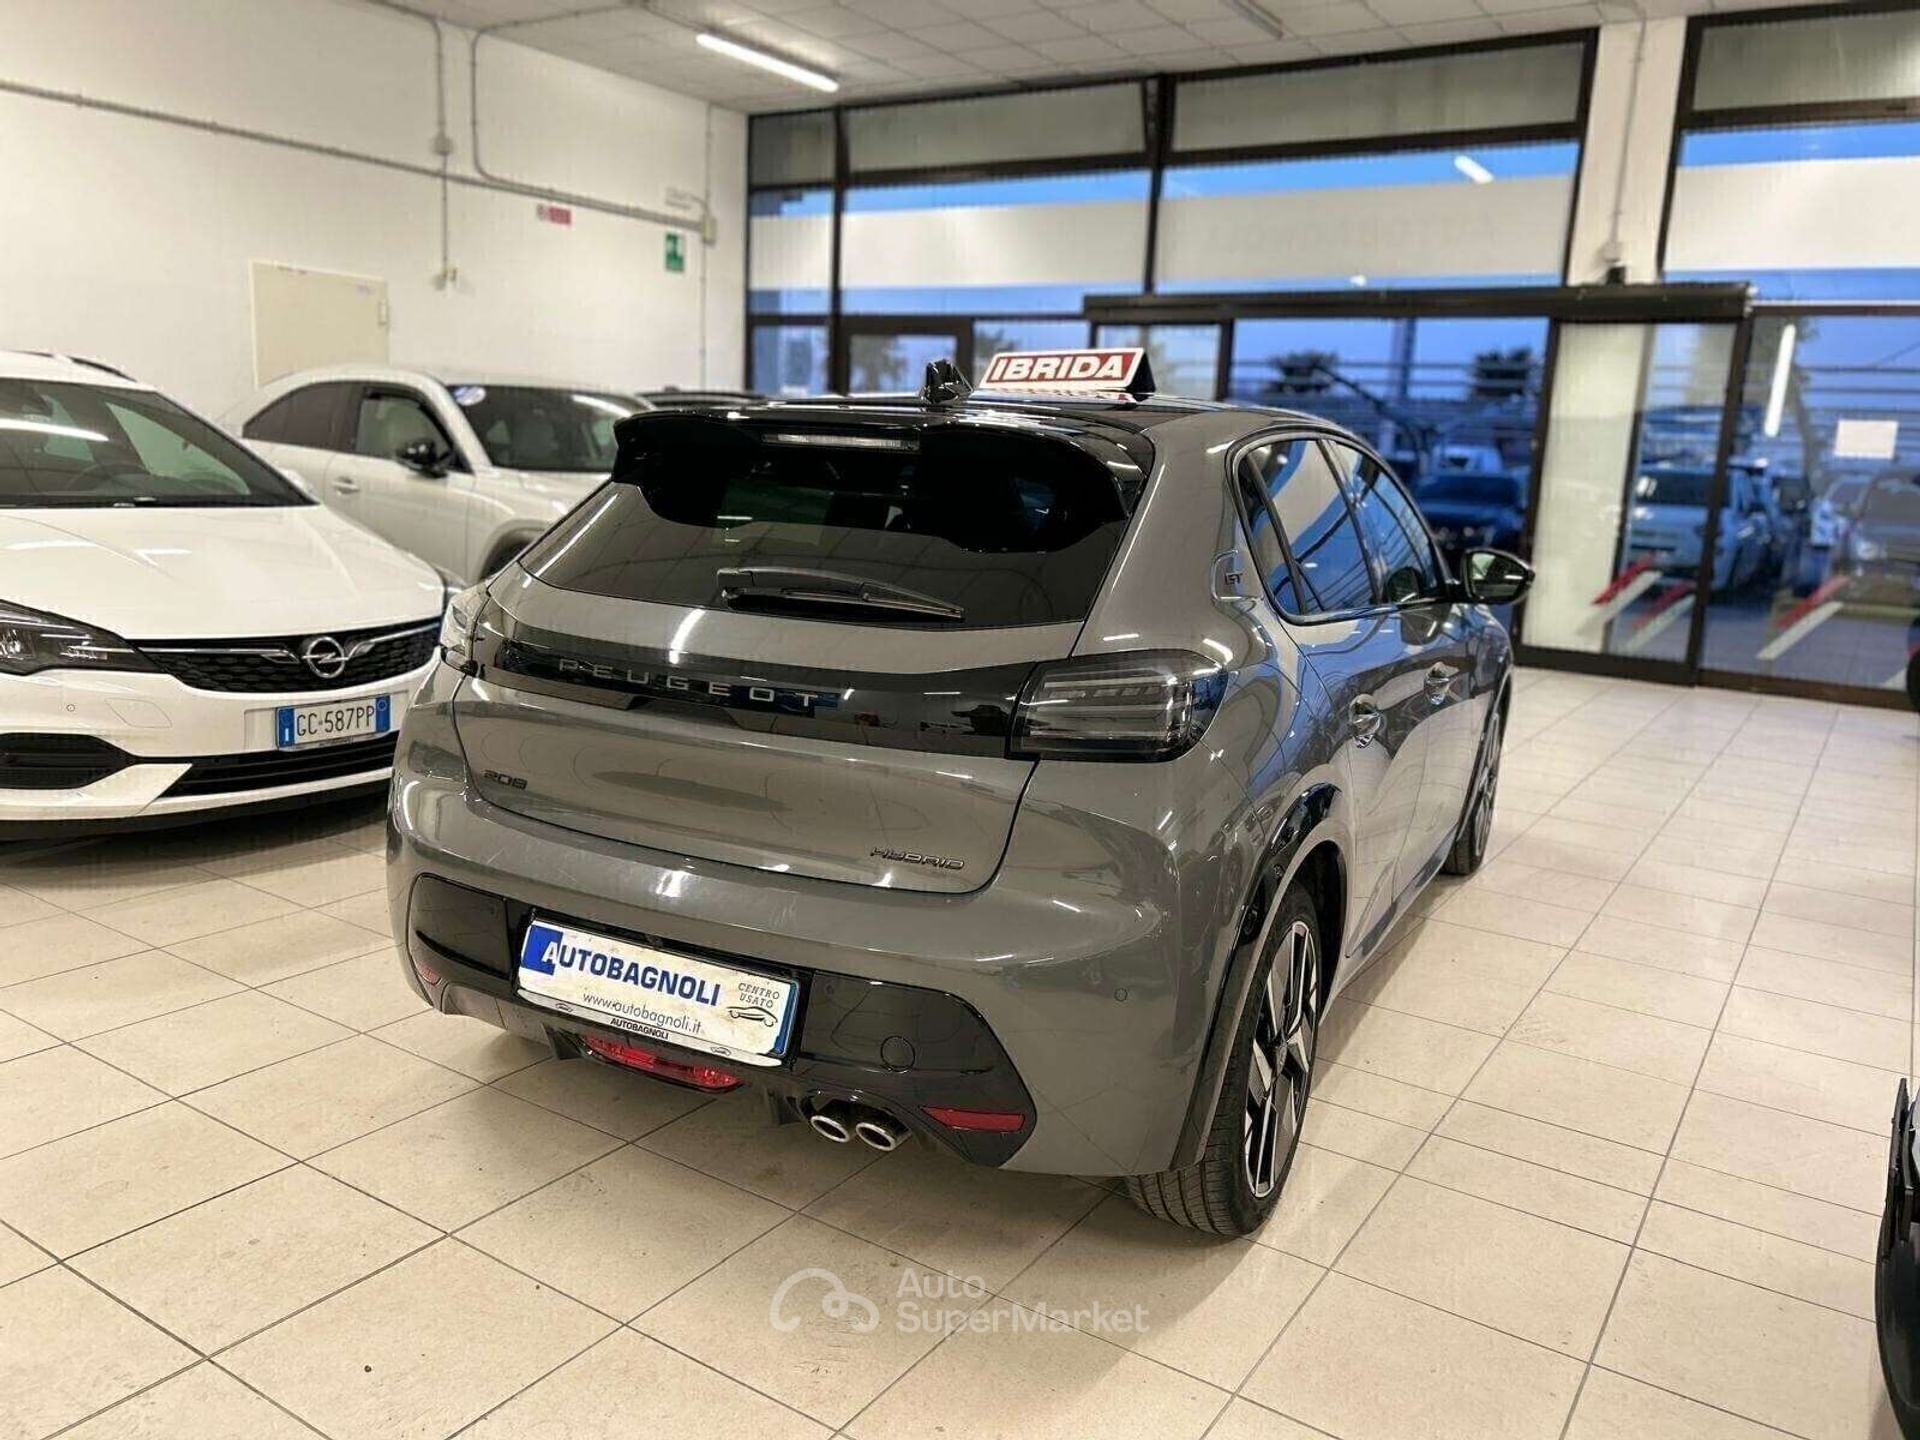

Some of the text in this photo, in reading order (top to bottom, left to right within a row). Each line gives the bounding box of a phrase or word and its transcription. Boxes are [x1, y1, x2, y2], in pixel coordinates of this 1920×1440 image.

[990, 354, 1125, 382] IBRIDA
[558, 658, 819, 707] PEUGEOT
[483, 769, 528, 790] 208
[869, 847, 965, 870] HYBRID
[541, 940, 721, 1007] AUTOBAGNOLI
[738, 982, 780, 1000] CENTRO
[739, 993, 774, 1008] USATO
[583, 991, 702, 1034] www.autobagnoli.it
[610, 1018, 669, 1040] AUTOBAGNOLI
